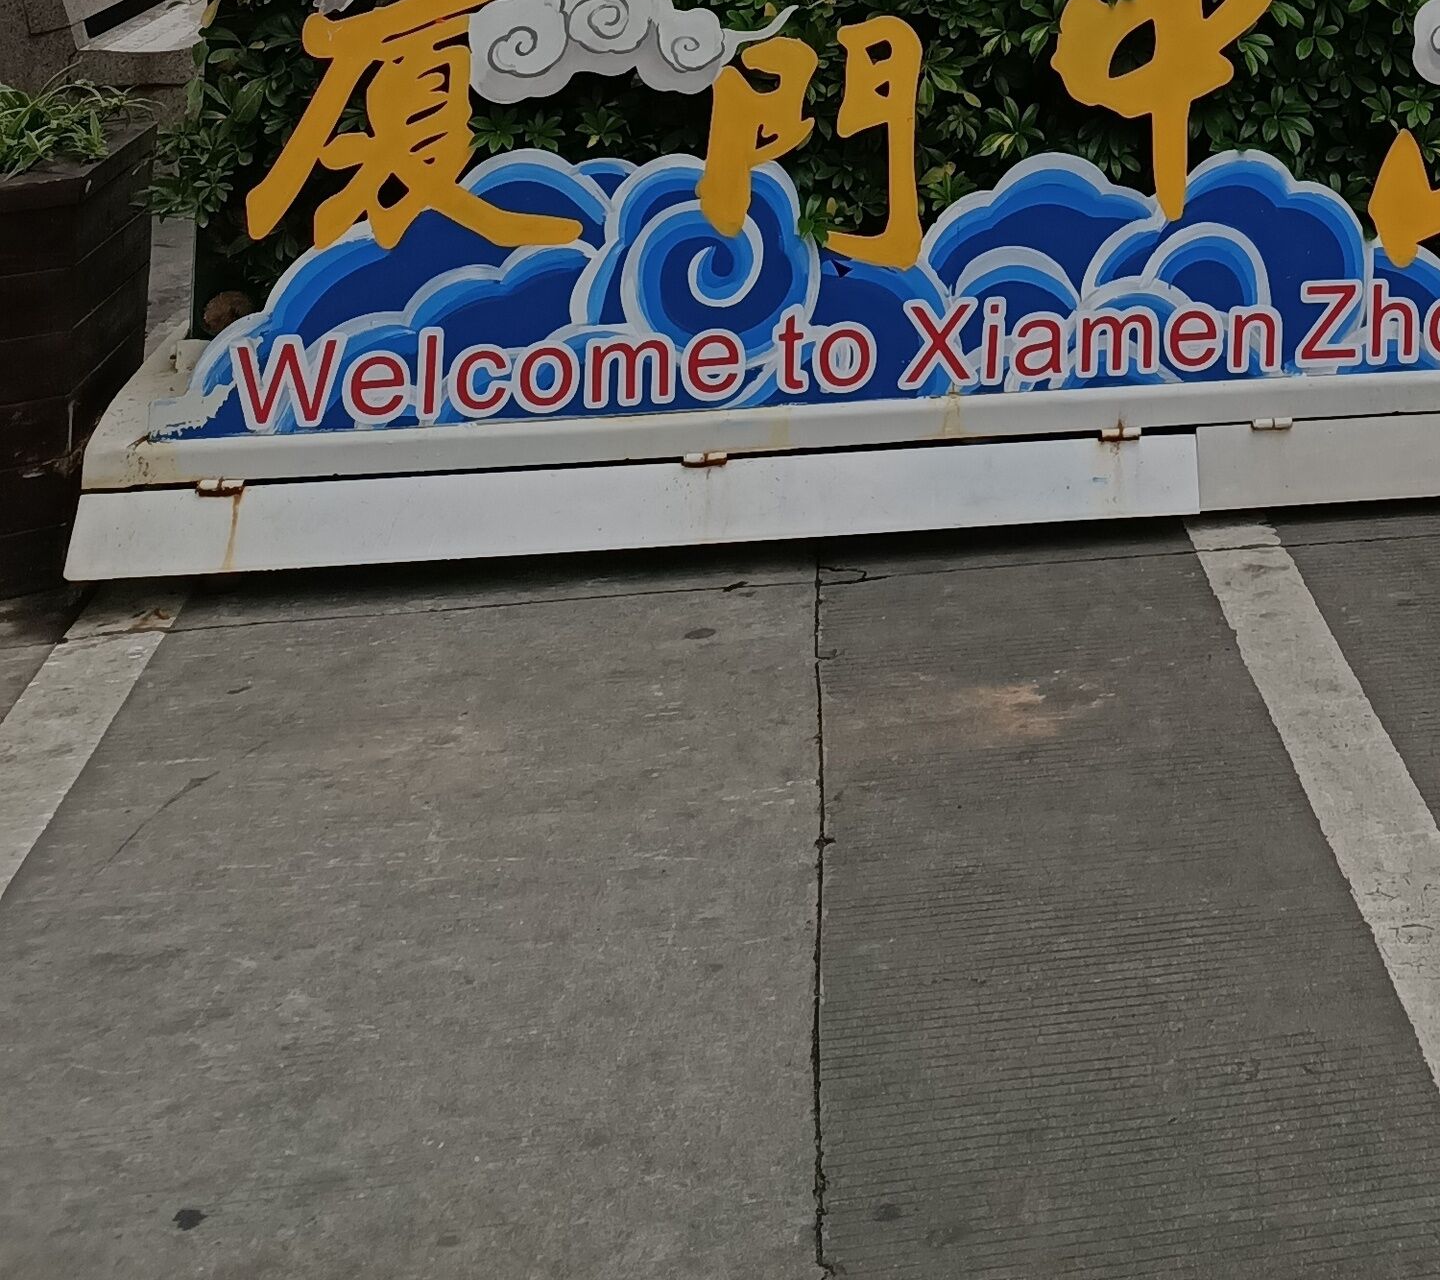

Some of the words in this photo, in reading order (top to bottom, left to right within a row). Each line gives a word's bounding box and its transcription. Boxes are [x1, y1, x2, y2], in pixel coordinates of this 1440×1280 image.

[234, 332, 742, 425] Welcome
[778, 316, 873, 392] to
[903, 300, 1277, 390] Xiamen
